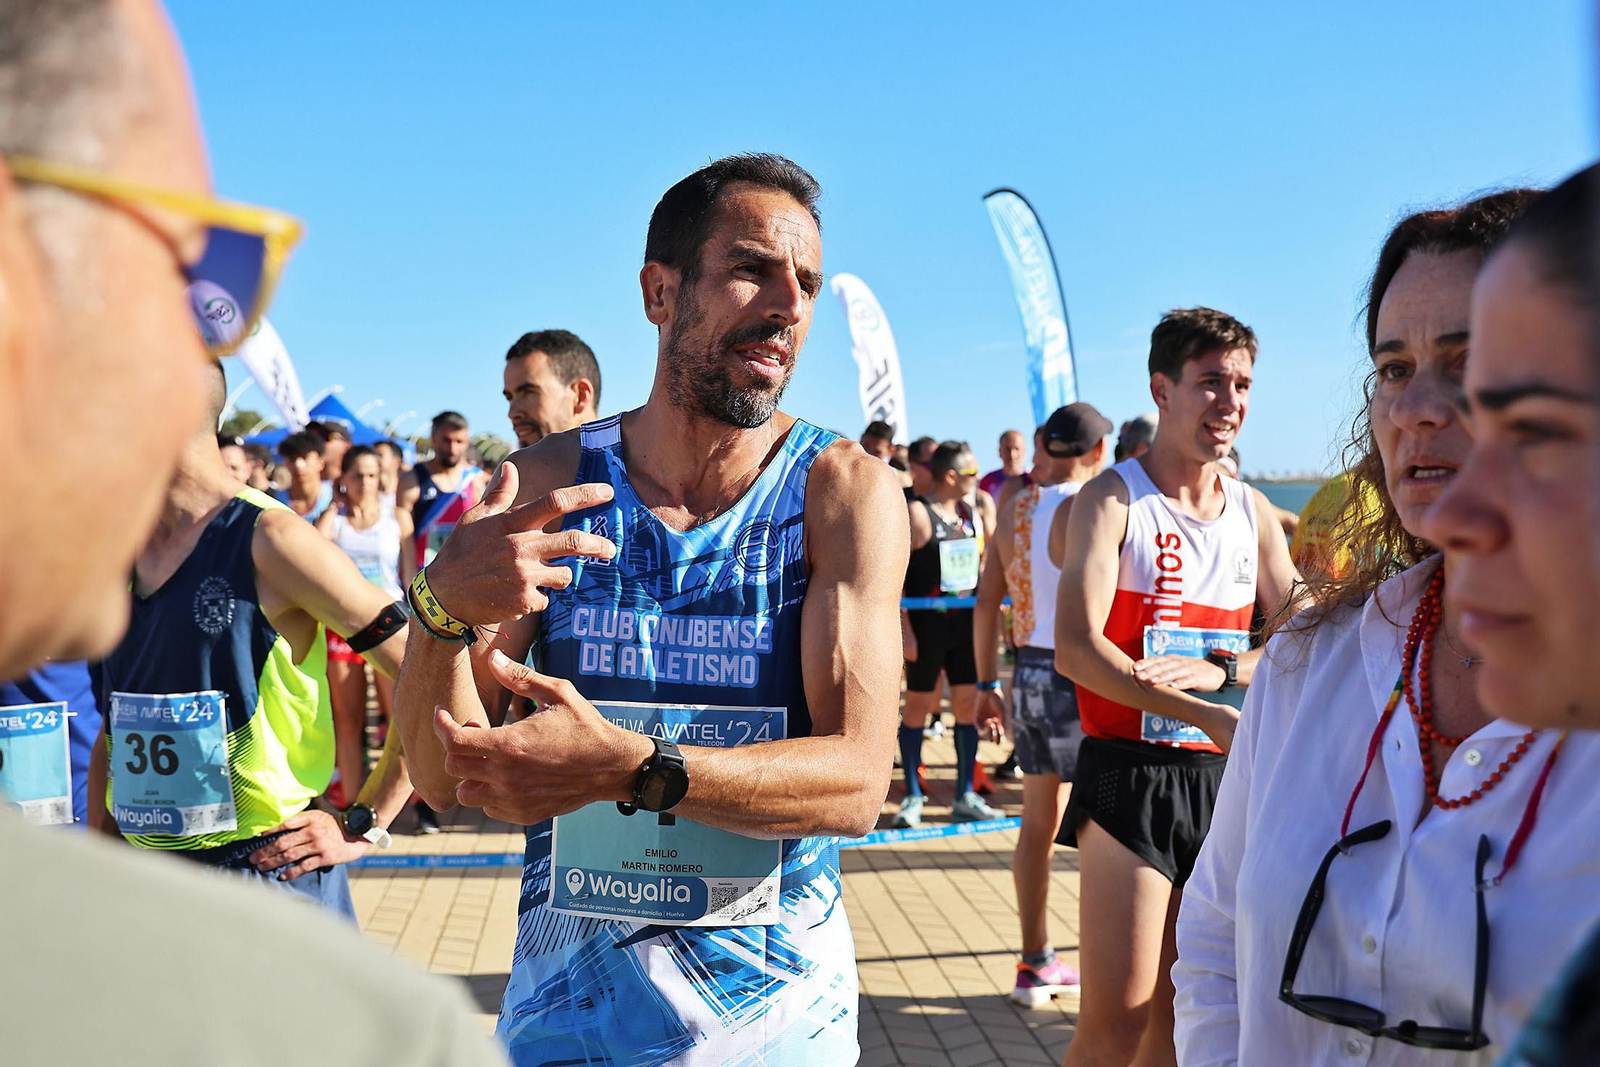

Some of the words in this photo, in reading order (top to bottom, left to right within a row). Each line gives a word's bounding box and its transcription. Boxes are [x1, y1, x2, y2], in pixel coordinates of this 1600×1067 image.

[573, 607, 634, 639] CLUB
[640, 614, 770, 650] ONUBENSE
[582, 643, 613, 673] DE
[621, 646, 756, 685] ATLETISMO
[652, 722, 726, 740] AVATEL
[125, 733, 179, 776] 36
[119, 807, 173, 827] Wayalia
[645, 848, 678, 858] EMILIO
[621, 861, 657, 872] MARTIN
[658, 863, 703, 874] ROMERO
[588, 872, 691, 904] Wayalia
[595, 904, 617, 912] personas
[617, 907, 637, 915] mayores
[641, 909, 663, 917] domicilio
[666, 910, 685, 918] Huelva
